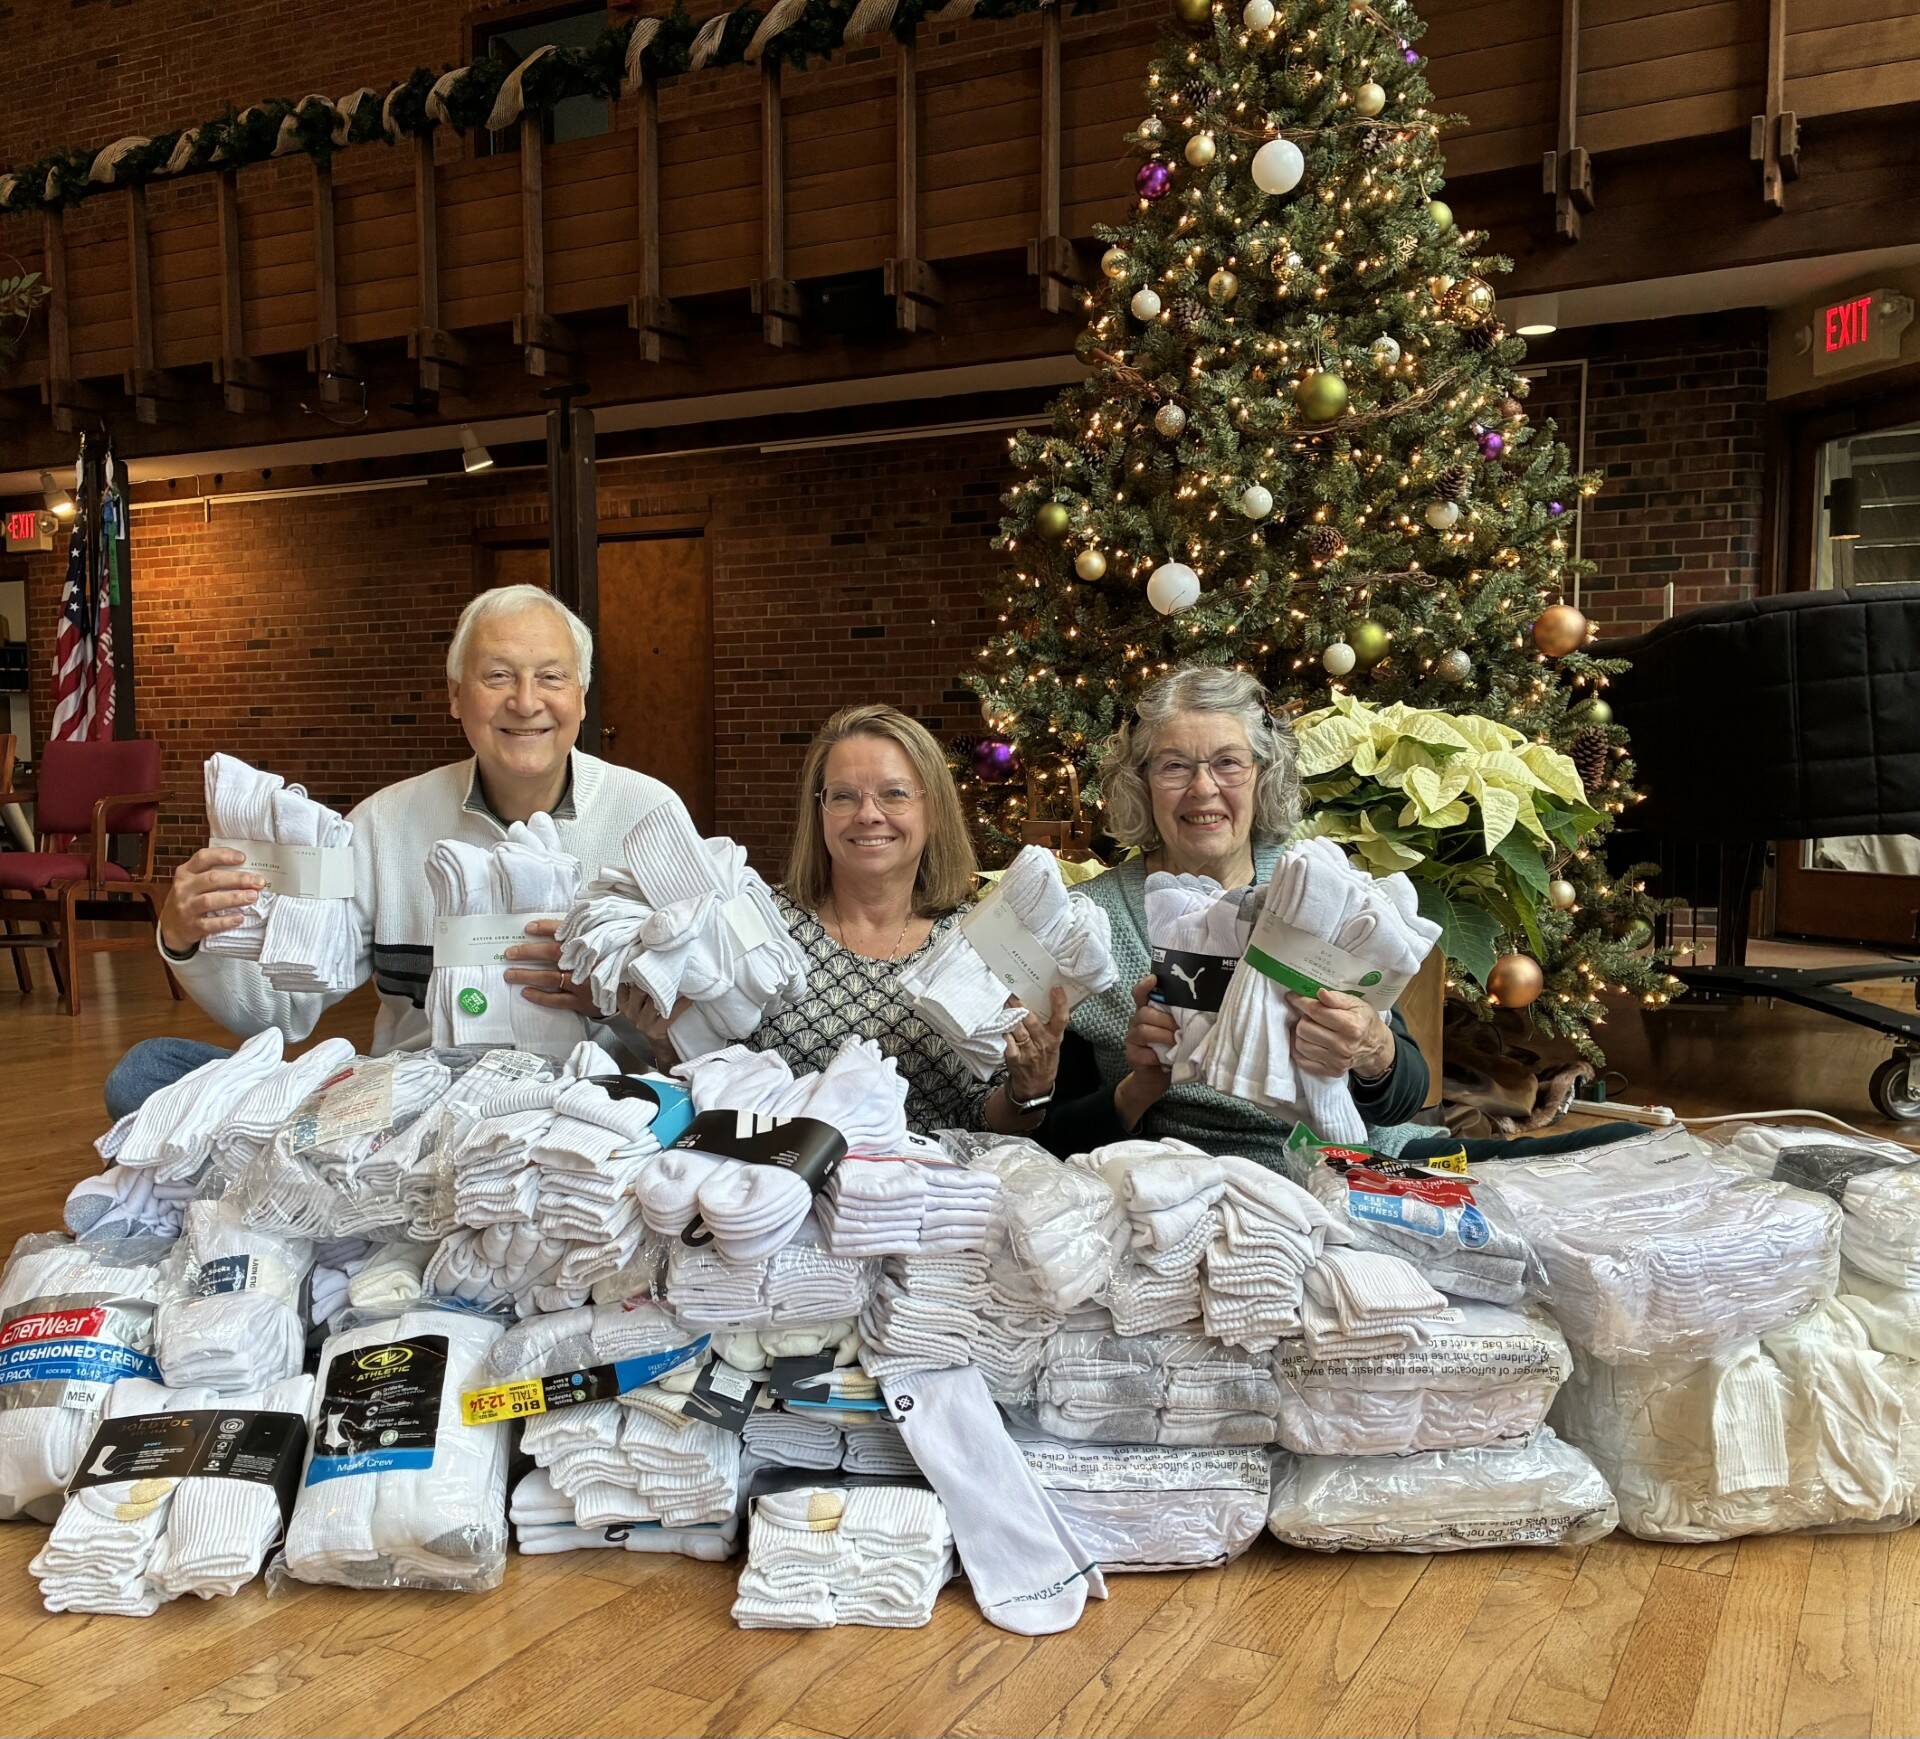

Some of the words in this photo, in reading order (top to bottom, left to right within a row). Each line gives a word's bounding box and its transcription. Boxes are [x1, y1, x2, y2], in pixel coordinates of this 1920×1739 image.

[1826, 297, 1871, 352] EXIT
[12, 512, 35, 540] EXIT
[1431, 1160, 1451, 1169] BIG
[1482, 1341, 1504, 1350] bag
[11, 1345, 96, 1363] CUSHIONED
[101, 1350, 144, 1371] CREW
[1409, 1352, 1428, 1361] this
[6, 1368, 33, 1382] PACK
[356, 1365, 411, 1382] ATHLETIC
[1328, 1366, 1349, 1376] bag
[1386, 1366, 1406, 1376] this
[1408, 1366, 1435, 1376] keep
[1498, 1367, 1510, 1376] of
[67, 1390, 95, 1402] MEN
[509, 1388, 533, 1402] TALL
[469, 1393, 506, 1413] 12-14
[512, 1400, 541, 1413] BIG
[1228, 1448, 1248, 1458] and
[366, 1459, 394, 1468] Crew
[1192, 1462, 1202, 1471] of
[1081, 1464, 1099, 1474] this
[1012, 1582, 1064, 1602] STANCE
